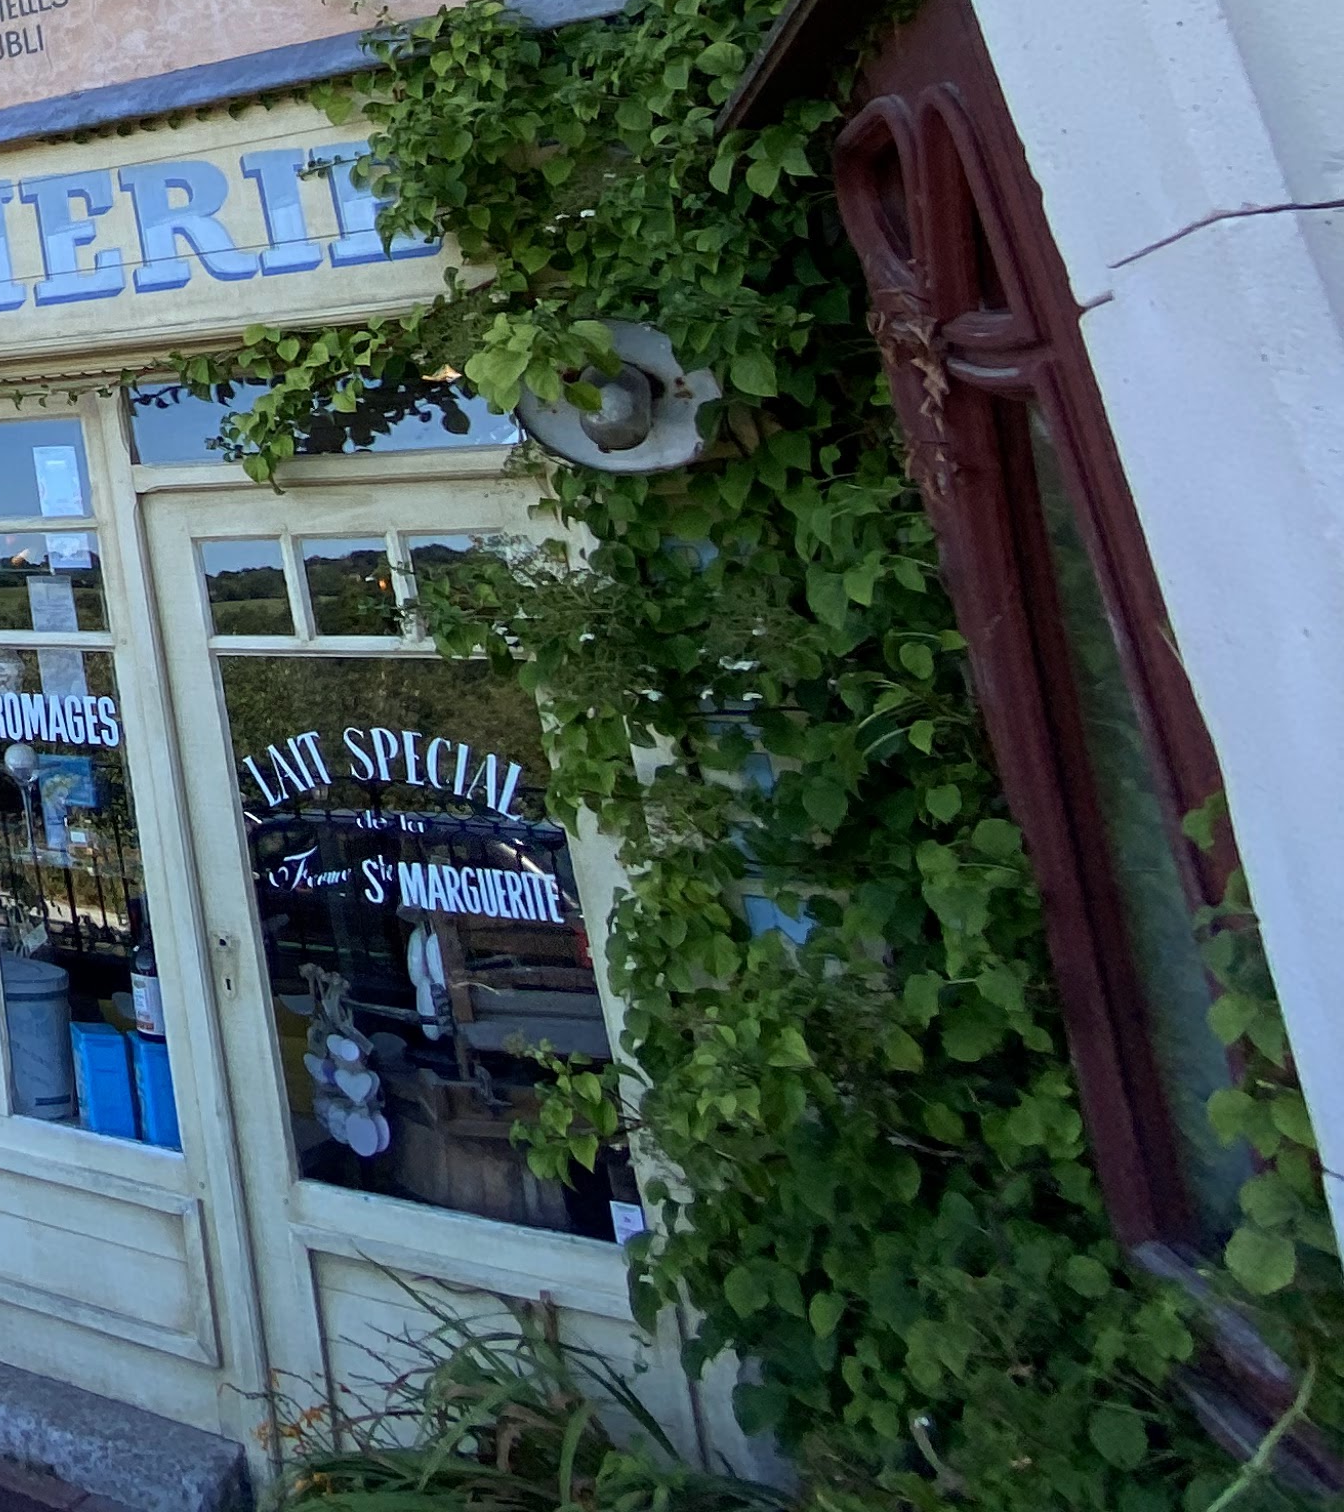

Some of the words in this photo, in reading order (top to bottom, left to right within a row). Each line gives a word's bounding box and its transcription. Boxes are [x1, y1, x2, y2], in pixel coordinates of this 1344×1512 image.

[242, 731, 332, 808] LAIT
[343, 725, 523, 822] SPECIAL
[398, 861, 565, 924] MARGUERITE
